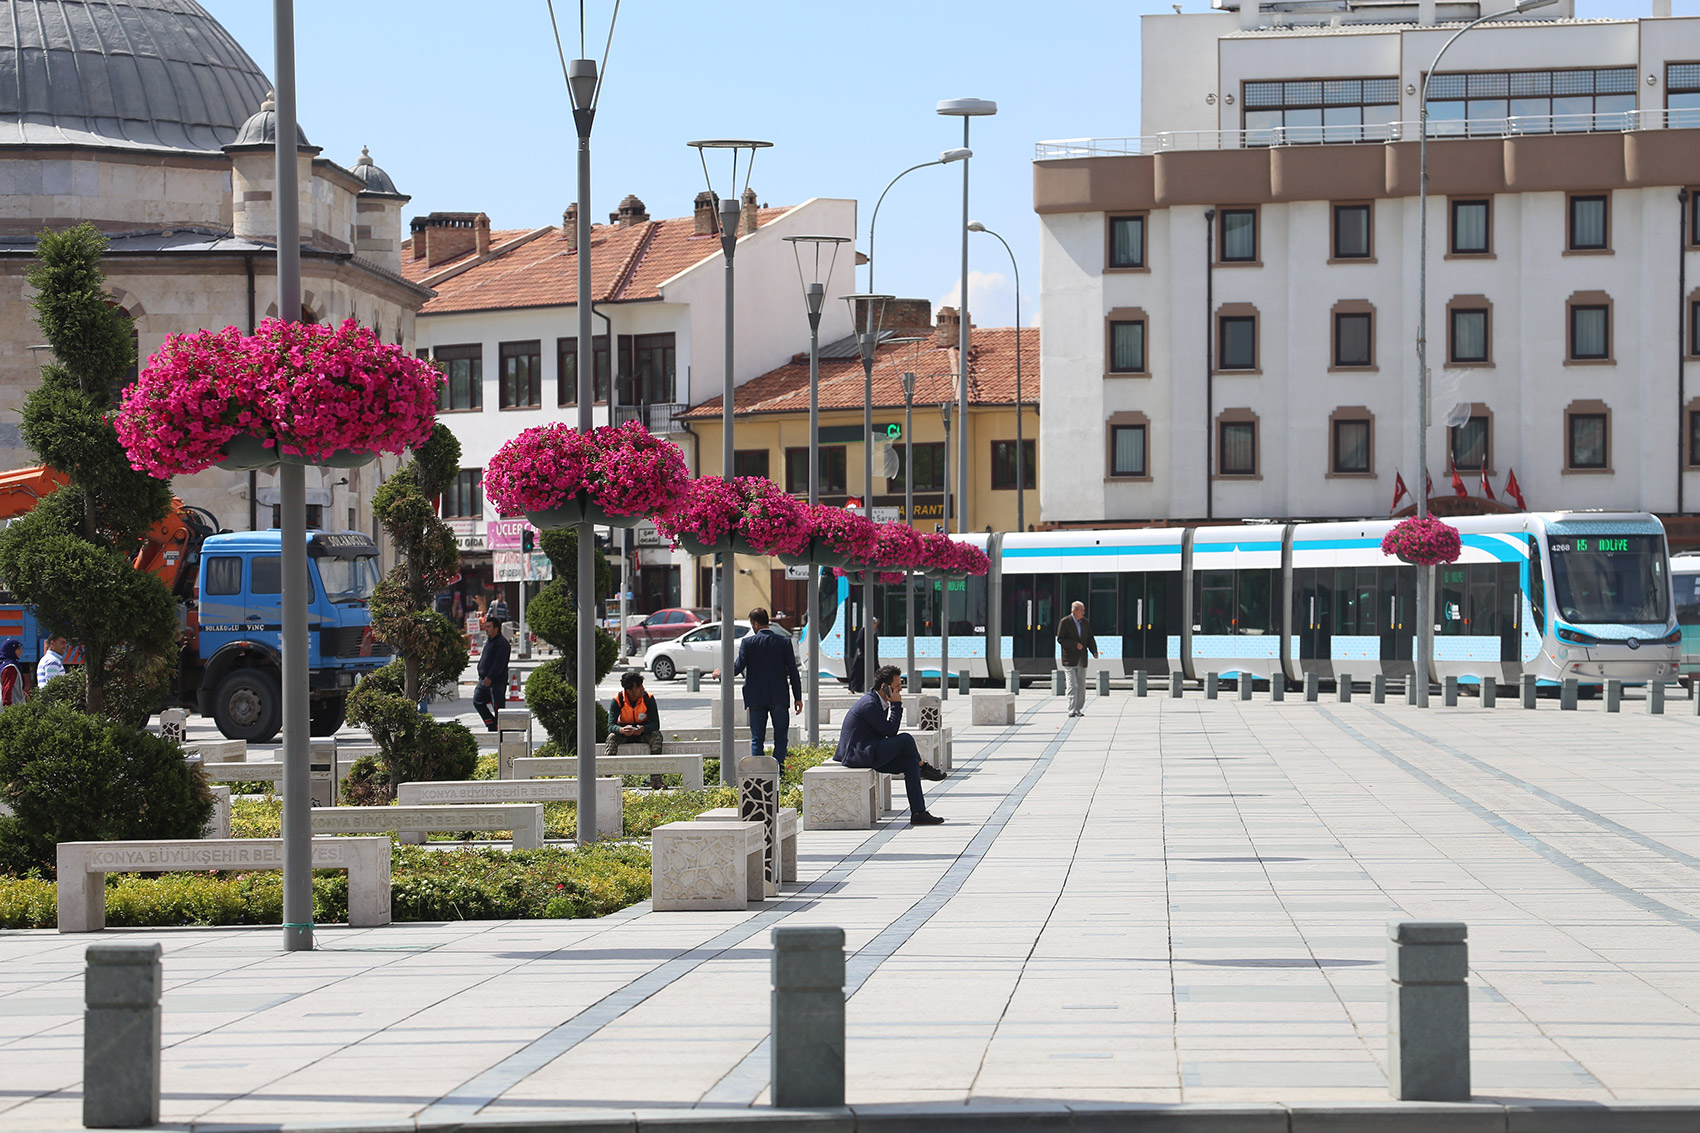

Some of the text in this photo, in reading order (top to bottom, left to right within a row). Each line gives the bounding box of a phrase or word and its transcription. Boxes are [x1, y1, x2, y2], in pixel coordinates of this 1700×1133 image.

[1551, 544, 1571, 552] 4268
[531, 784, 578, 797] BELEDİY
[92, 843, 344, 866] KONYA BÜYÜKŞEHİR BELESİ
